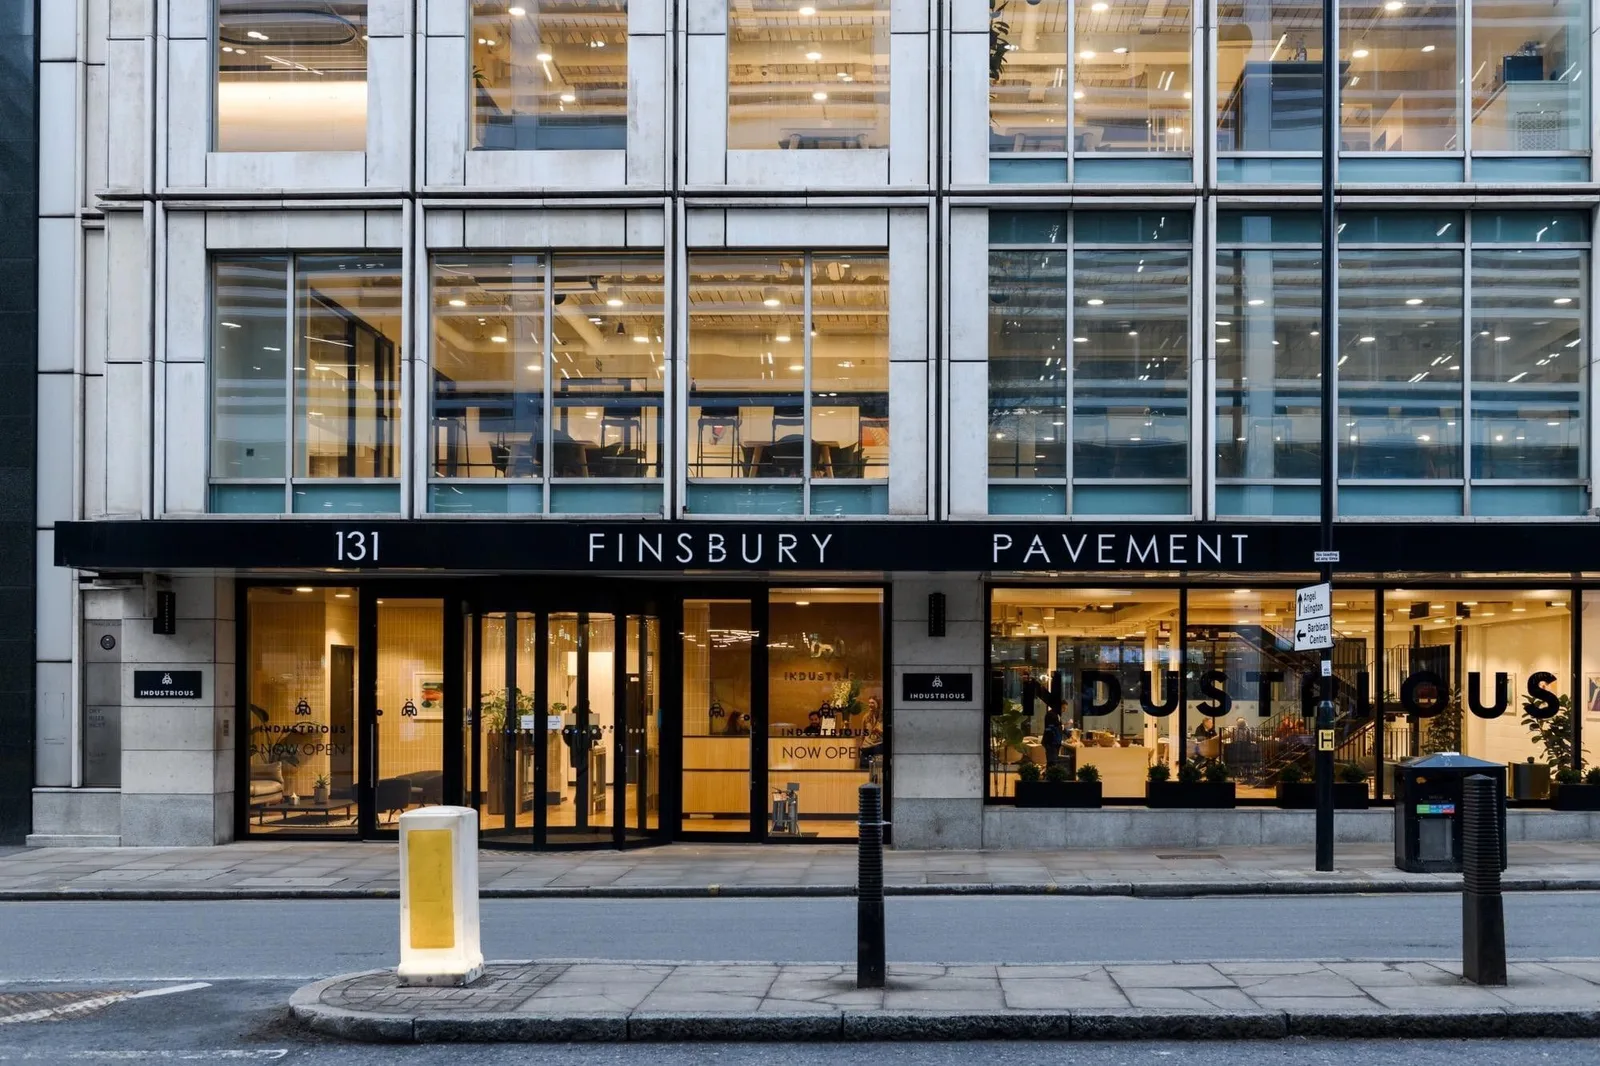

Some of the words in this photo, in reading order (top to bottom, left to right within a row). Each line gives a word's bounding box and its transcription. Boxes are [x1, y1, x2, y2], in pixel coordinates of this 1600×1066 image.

[335, 531, 378, 561] 131
[589, 533, 833, 563] FINSBURY
[993, 534, 1248, 563] PAVEMENT
[1303, 591, 1316, 602] Angel
[1304, 604, 1323, 614] Islington
[1308, 622, 1328, 633] Barbican
[1310, 635, 1327, 644] Centre
[260, 725, 346, 734] INDUSTRIOUS
[781, 728, 870, 736] INDUSTRIOUS
[261, 744, 298, 756] NOW
[303, 744, 345, 756] OPEN
[782, 746, 821, 759] NOW
